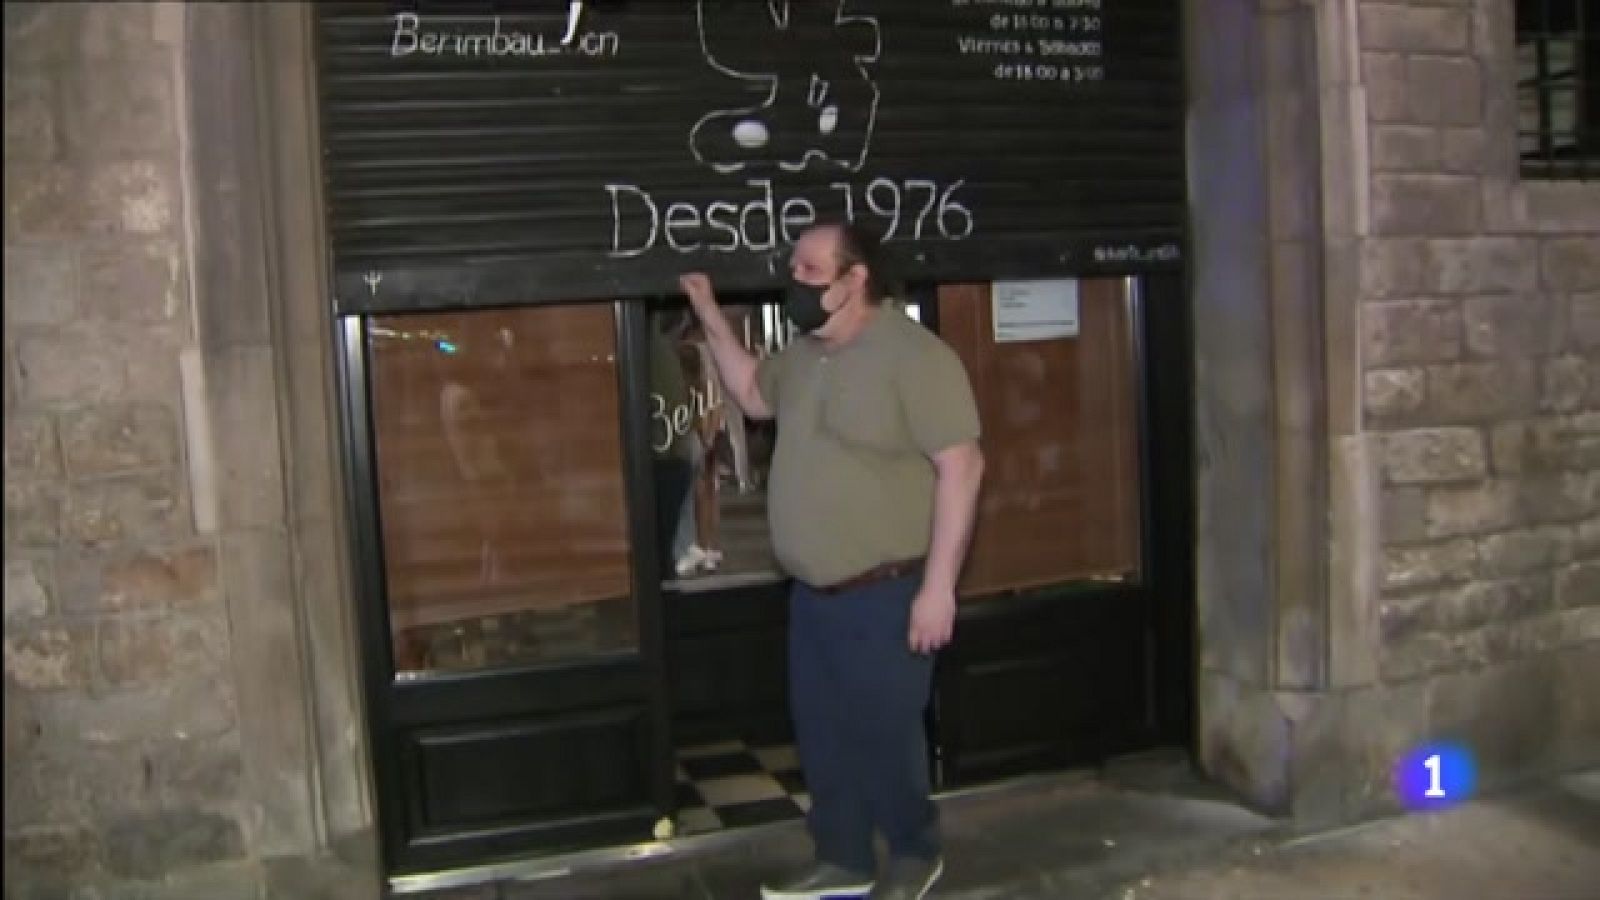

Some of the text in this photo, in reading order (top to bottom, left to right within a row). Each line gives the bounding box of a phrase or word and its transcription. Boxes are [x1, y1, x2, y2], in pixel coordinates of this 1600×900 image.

[391, 12, 620, 56] Berimbau_cn
[604, 177, 974, 258] Desde 1976
